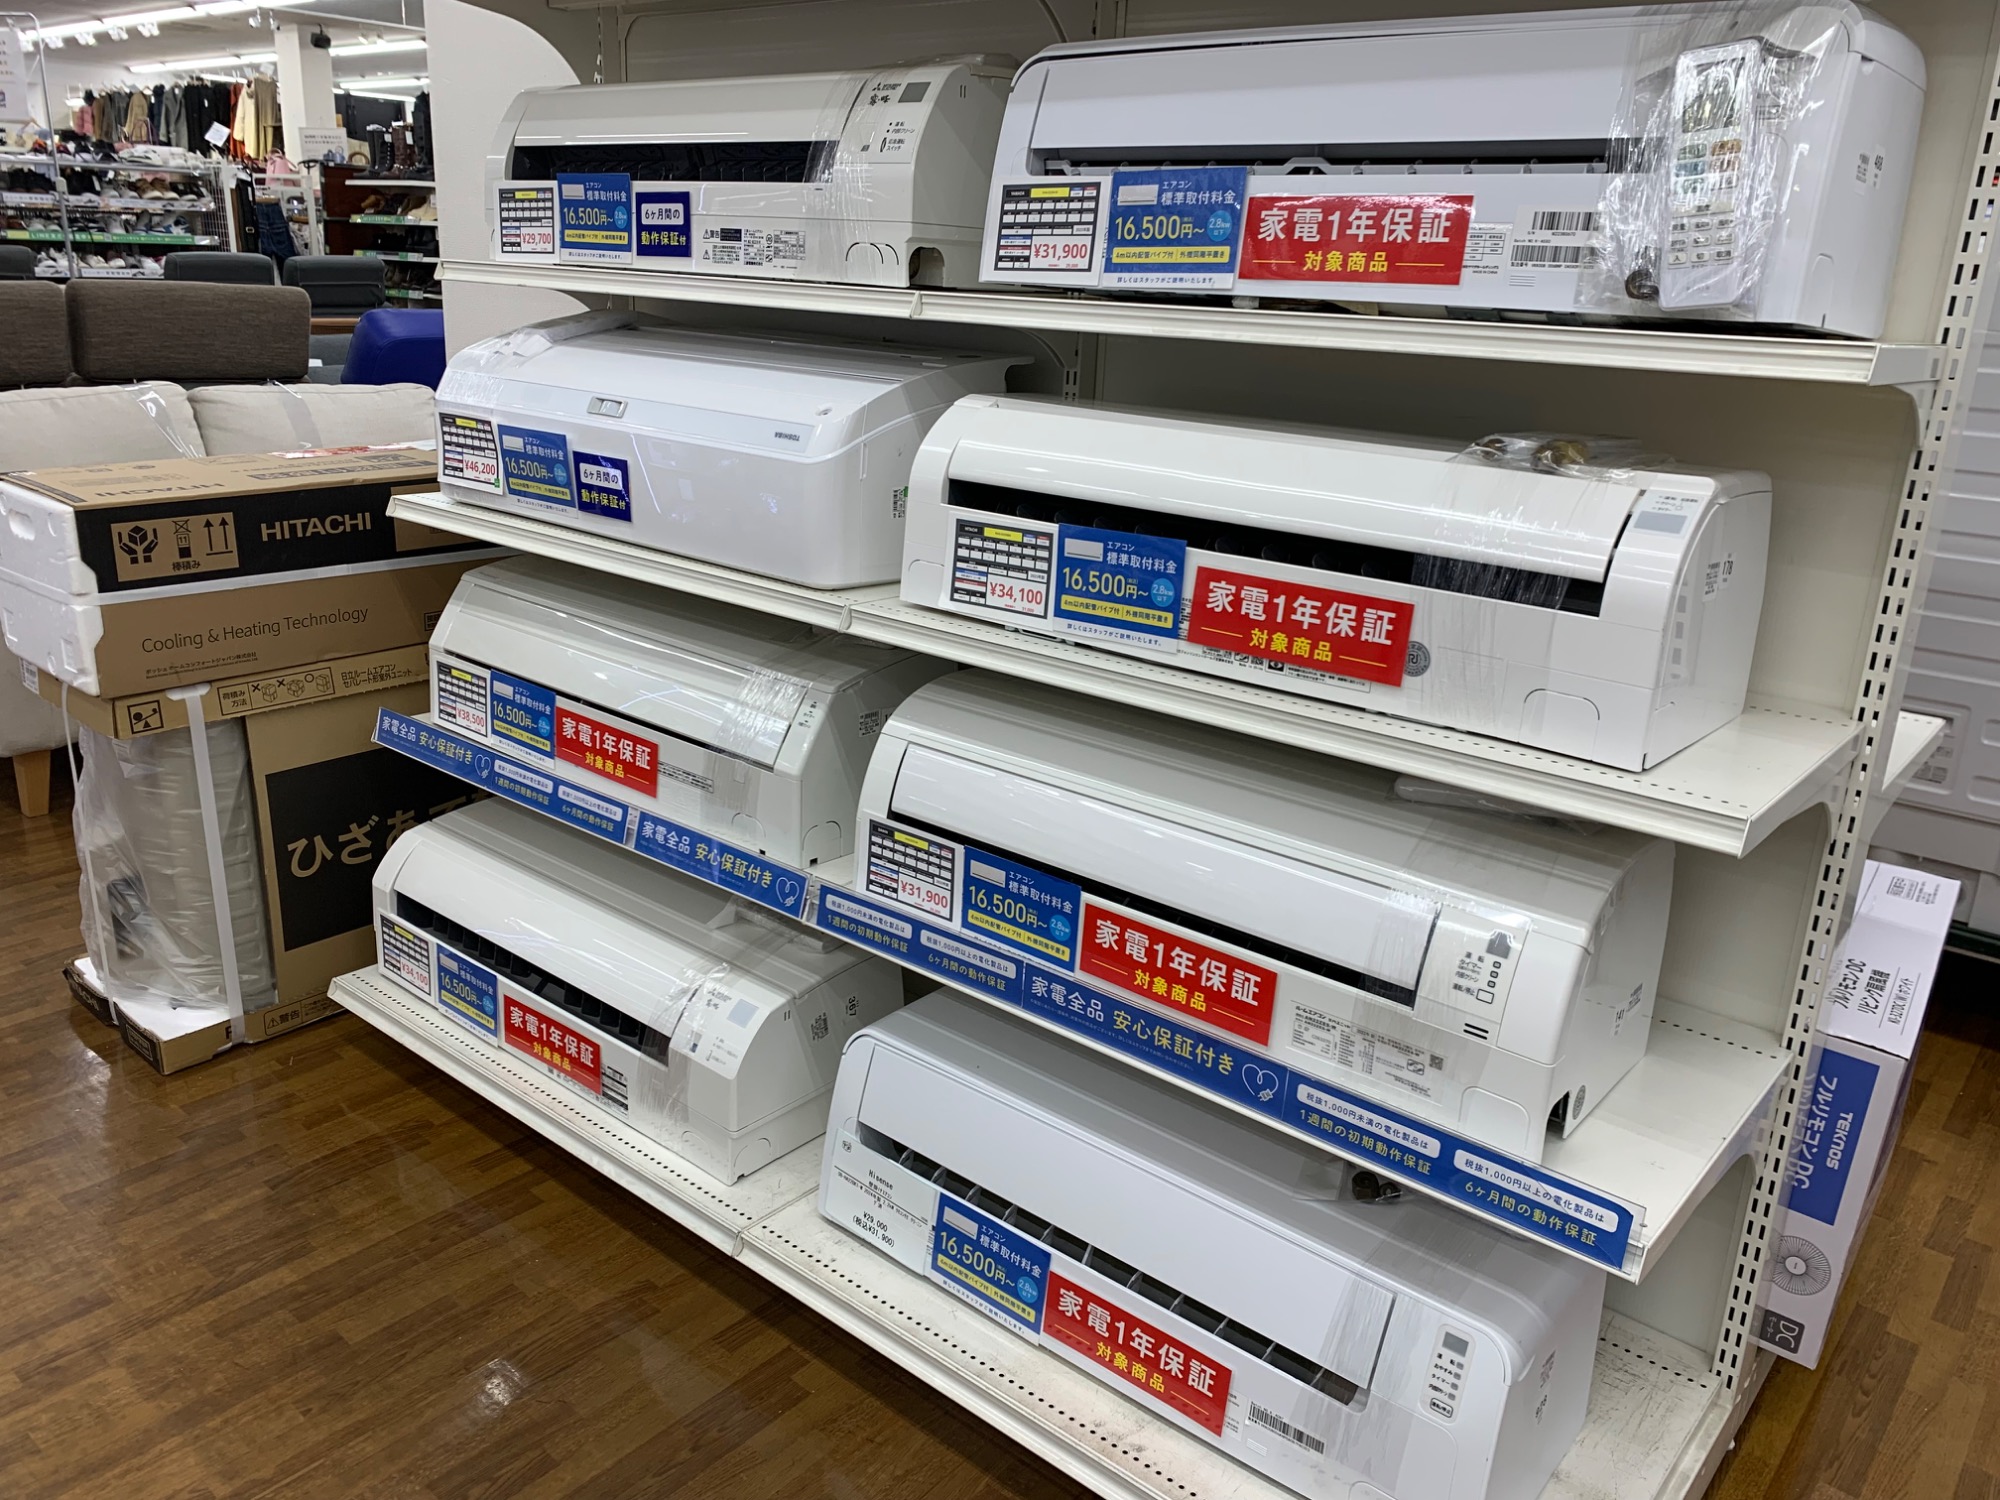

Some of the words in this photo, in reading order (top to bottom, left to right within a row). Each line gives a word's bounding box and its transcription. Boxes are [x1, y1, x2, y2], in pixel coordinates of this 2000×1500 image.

[586, 190, 627, 202] 標準取付料金
[1161, 189, 1236, 206] 標準取付料金
[1162, 180, 1192, 190] エアコン
[563, 206, 614, 226] 16,500円〜
[644, 208, 681, 220] 6ヶ月間の
[1257, 206, 1452, 245] 家電1年保証
[522, 232, 552, 245] ¥29,700
[641, 230, 687, 246] 動作保証付
[1115, 215, 1205, 240] 16,500円〜
[1033, 243, 1088, 261] ¥31,900
[1303, 249, 1389, 273] 対象商品
[524, 436, 540, 444] エアコン
[774, 431, 800, 442] TOSHIBA
[464, 459, 496, 476] ¥46,200
[505, 456, 554, 480] 16,500円〜
[583, 468, 619, 485] 6ヶ月間の
[581, 488, 626, 510] 動作保証付
[260, 512, 372, 541] HITACHI
[1107, 541, 1135, 552] エアコン
[171, 559, 201, 572] 棒積み
[1106, 551, 1177, 575] 標準取付料金
[989, 581, 1043, 605] ¥34,100
[1062, 567, 1149, 600] 16,500円〜
[1205, 579, 1397, 646] 家電1年保証
[141, 630, 204, 654] Cooling
[207, 628, 220, 644] &
[223, 617, 281, 640] Heating
[283, 606, 368, 630] Technology
[1249, 627, 1333, 662] 対象商品
[341, 663, 396, 681] 日立ルームエアコン
[343, 668, 412, 689] セパレート形室外ユニット
[231, 698, 247, 708] 方法
[515, 686, 530, 696] エアコン
[456, 707, 485, 728] ¥38,500
[493, 700, 538, 729] 16,500円〜
[382, 715, 417, 743] 家電全品
[419, 731, 473, 765] 安心保証付き
[561, 716, 651, 770] 家電1年保証
[584, 751, 626, 779] 対象商品
[641, 820, 691, 855] 家電全品
[695, 842, 774, 888] 安心保証付き
[1008, 870, 1035, 885] エアコン
[900, 879, 948, 909] ¥31,900
[969, 885, 1048, 929] 16,500円〜
[1008, 880, 1073, 915] 標準取付料金
[827, 914, 908, 953] 1週間の初期動作保証
[400, 960, 429, 986] ¥34,100
[928, 953, 1007, 992] 6ヶ月間の動作保証
[1094, 918, 1262, 1007] 家電1年保証
[1134, 968, 1207, 1012] 対象商品
[279, 1010, 300, 1024] 警告
[848, 995, 857, 1017] 367
[509, 1005, 595, 1068] 家電1年保証
[1031, 975, 1105, 1022] 家電全品
[1113, 1009, 1235, 1076] 安心保証付き
[533, 1041, 572, 1072] 対象商品
[1305, 1090, 1429, 1151] 税抜1,000円未満の電化製品は
[1299, 1108, 1432, 1176] 1週間の初期動作保証
[1826, 1112, 1854, 1171] TEKNOS
[868, 1169, 894, 1191] Hisense
[1464, 1158, 1605, 1225] 税抜1,000円以上の電化製品は
[863, 1211, 888, 1233] ¥29,000
[1464, 1180, 1598, 1247] 6ヶ月間の動作保証
[981, 1225, 1006, 1242] エアコン
[940, 1231, 1015, 1287] 16,500円〜
[980, 1234, 1042, 1279] 標準取付料金
[1058, 1287, 1217, 1398] 家電1年保証
[1775, 1320, 1800, 1351] DC
[1096, 1341, 1166, 1393] 対象商品
